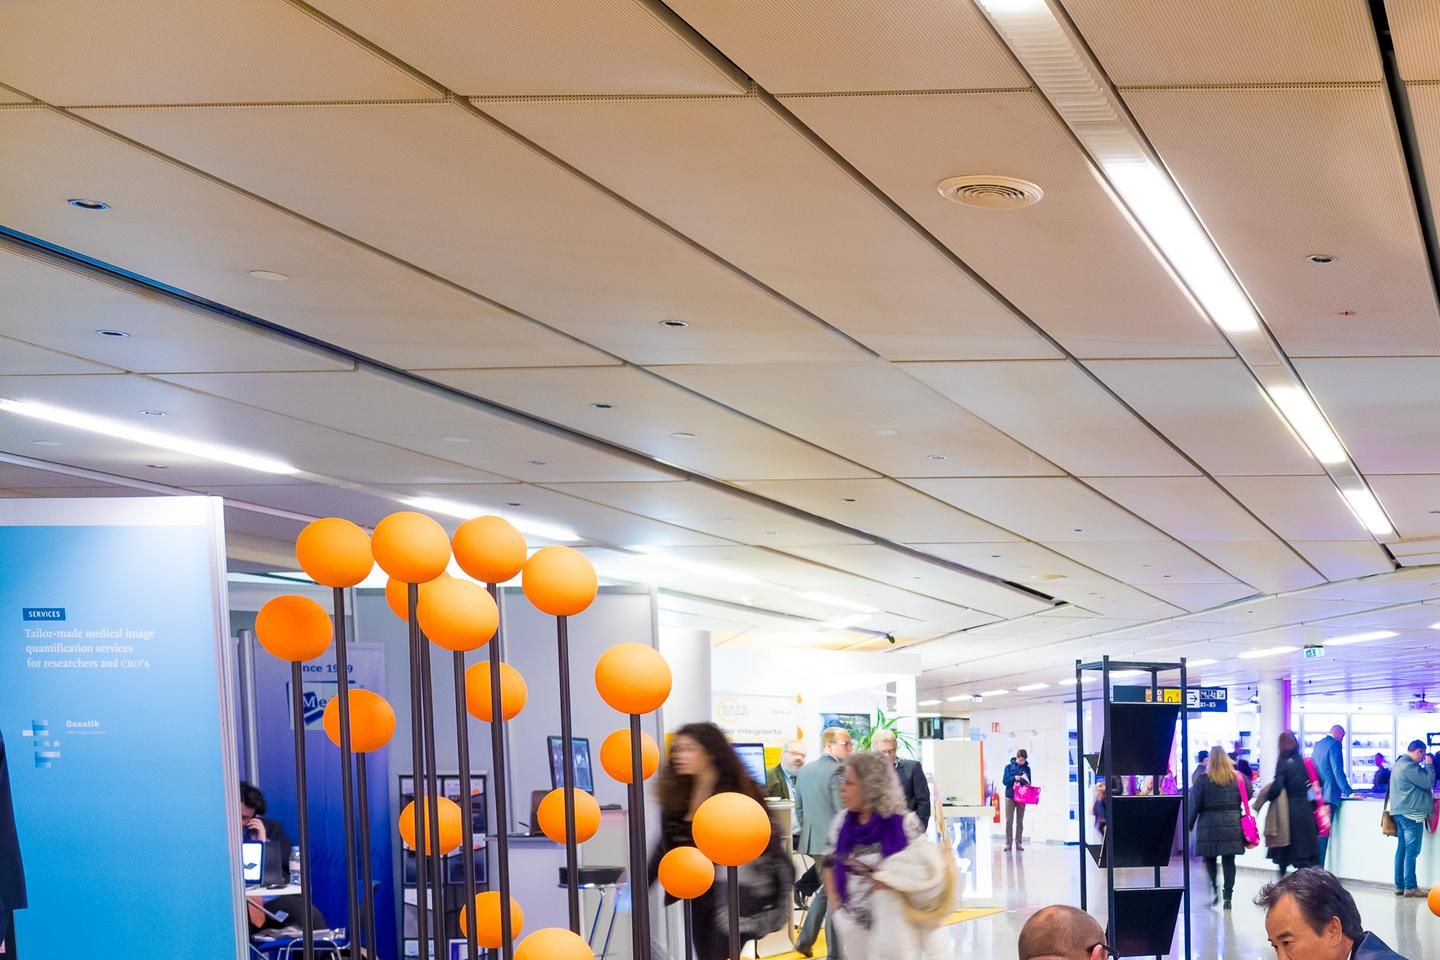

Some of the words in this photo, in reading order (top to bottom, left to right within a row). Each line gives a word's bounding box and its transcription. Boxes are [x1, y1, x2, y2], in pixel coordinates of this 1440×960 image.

[28, 610, 61, 618] SERVICES
[24, 628, 83, 639] Tailor-made
[85, 628, 122, 639] medical
[125, 628, 156, 641] image
[25, 643, 94, 655] quantification
[95, 644, 133, 654] services
[27, 658, 42, 669] for
[44, 658, 98, 669] researchers
[100, 659, 118, 669] and
